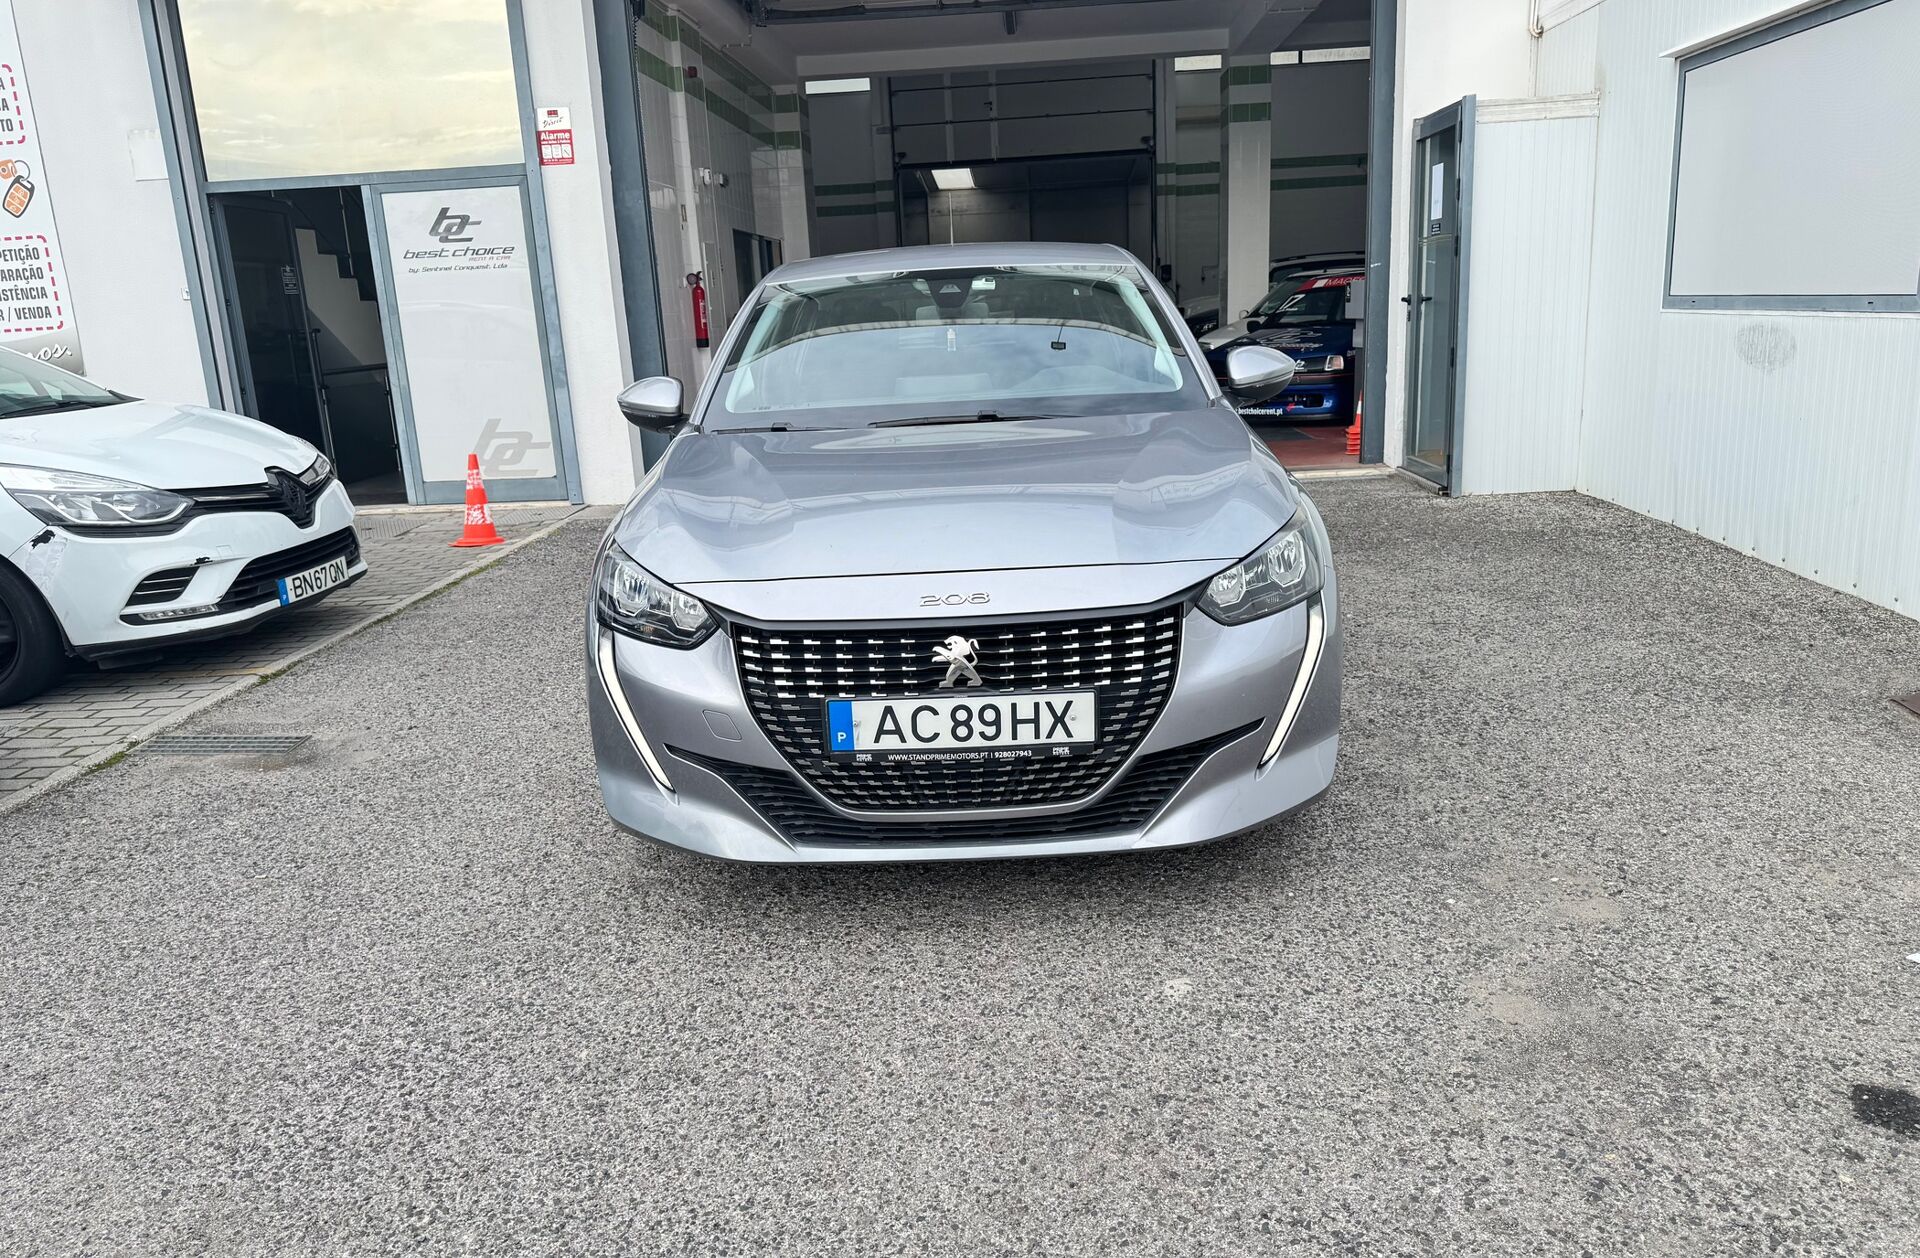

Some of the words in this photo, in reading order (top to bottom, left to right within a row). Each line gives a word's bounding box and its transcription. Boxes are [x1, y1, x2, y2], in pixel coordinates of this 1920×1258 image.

[0, 98, 10, 111] A
[541, 131, 570, 141] Alarme
[403, 248, 450, 259] best
[452, 247, 515, 258] choice
[422, 265, 452, 273] Sentinel
[14, 305, 52, 321] VENDA
[1235, 407, 1283, 416] bestchoicerent.pt
[920, 593, 991, 607] 208
[837, 731, 847, 743] P
[888, 751, 988, 761] WWW.STANDPRIMEMOTORS.PT
[995, 750, 1032, 758] 928027943
